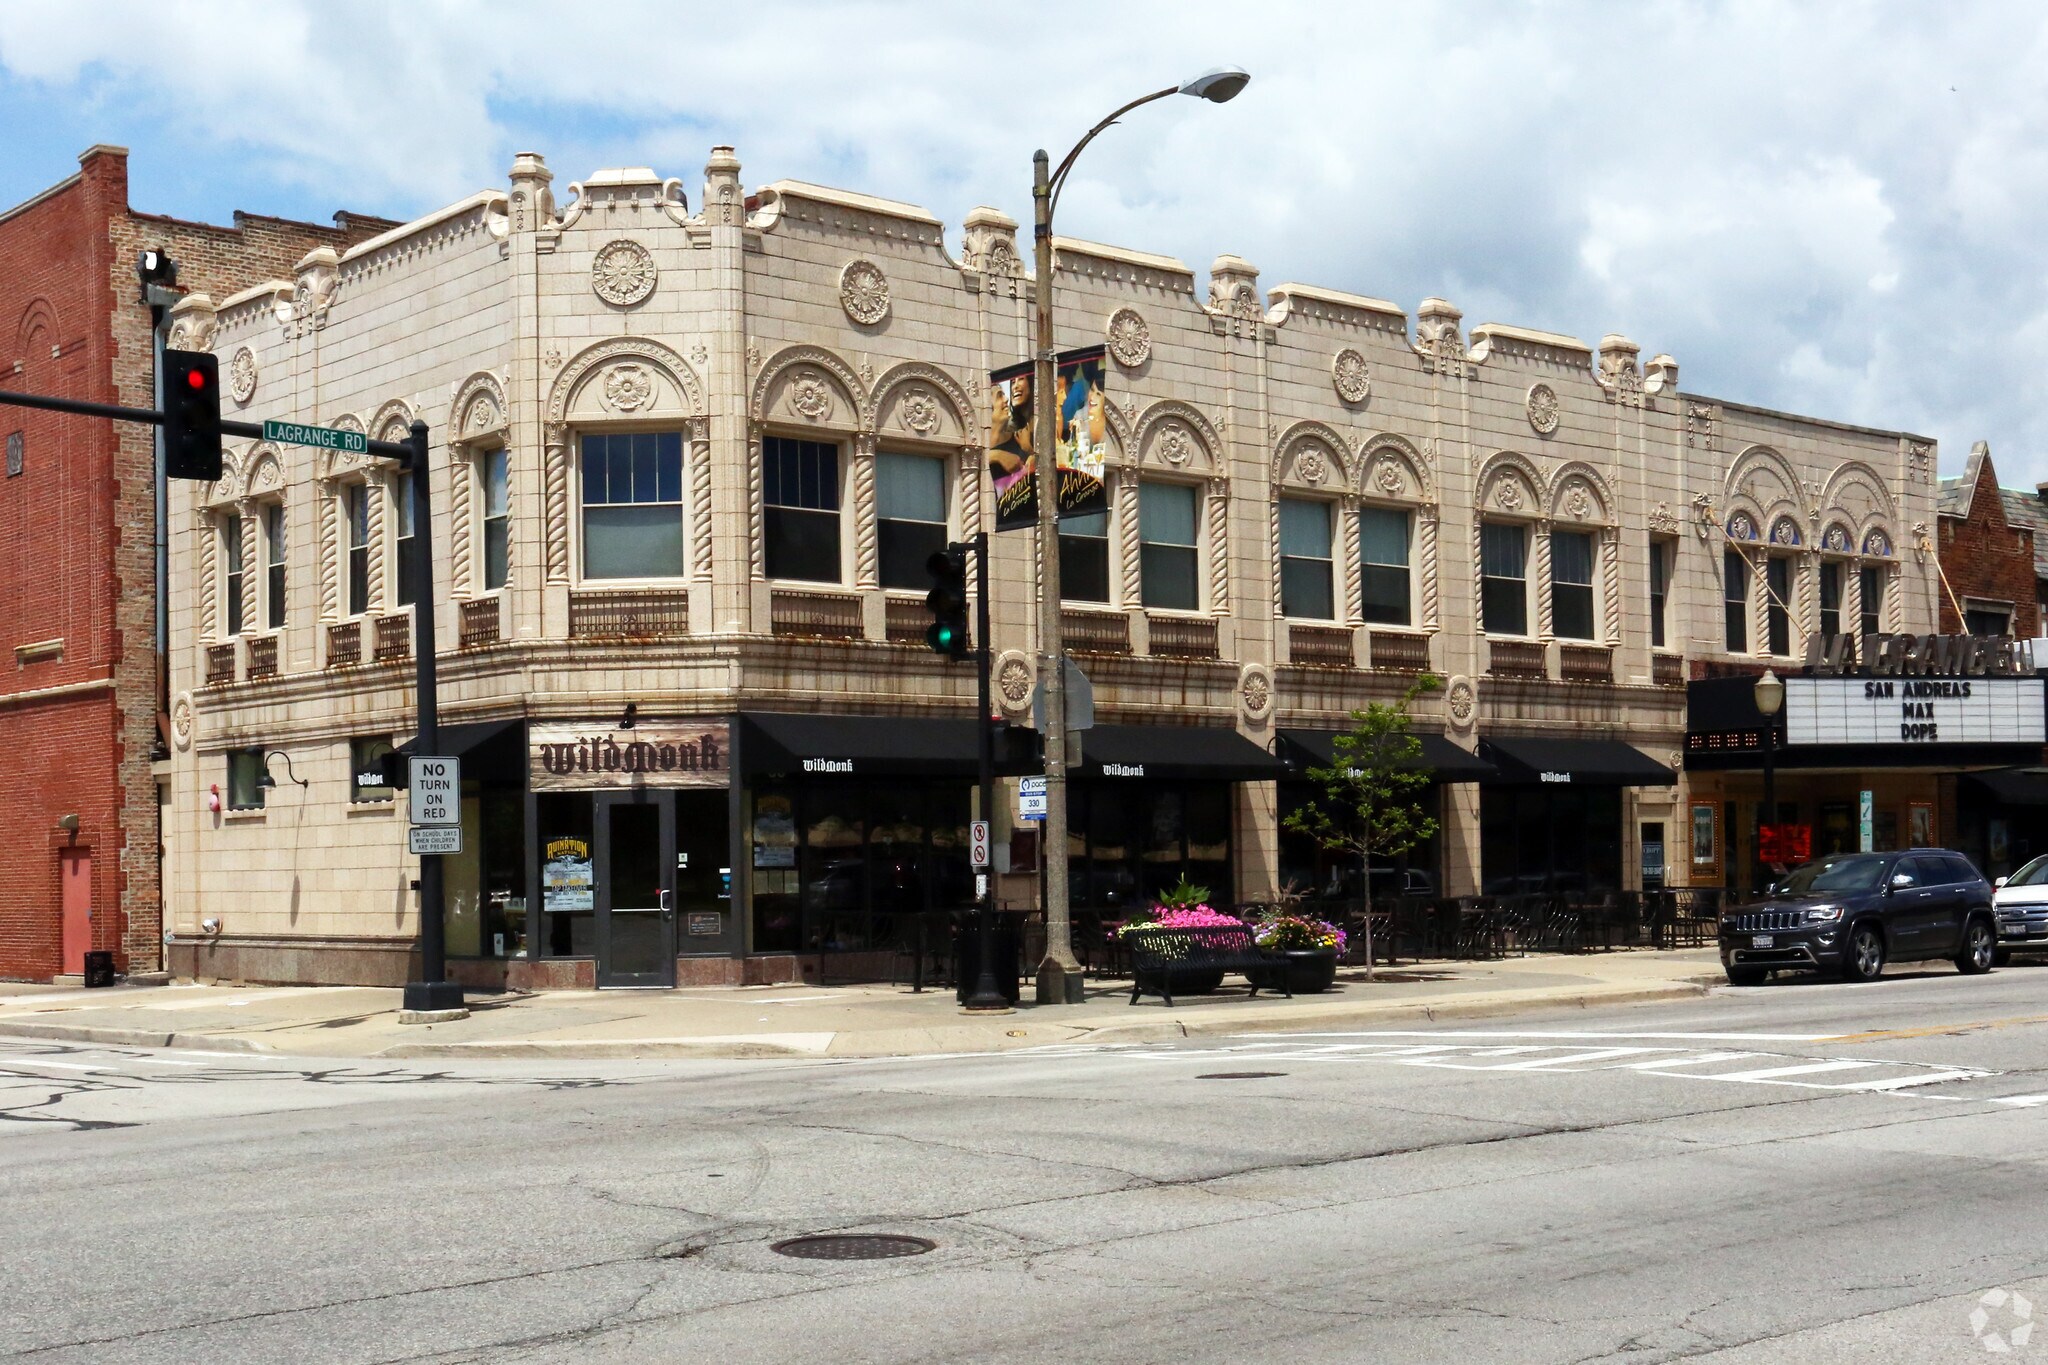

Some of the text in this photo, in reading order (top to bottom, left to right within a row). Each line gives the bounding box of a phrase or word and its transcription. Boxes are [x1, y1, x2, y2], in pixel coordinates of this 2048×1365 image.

[267, 422, 363, 450] LAGRANGE RD
[1864, 681, 1971, 698] SAN ANDREAS
[1902, 702, 1934, 719] MAX
[1901, 723, 1938, 740] DOPE
[423, 764, 445, 776] NO
[420, 780, 450, 790] TURN
[426, 795, 443, 804] ON
[1028, 799, 1040, 807] 330
[424, 808, 446, 818] RED
